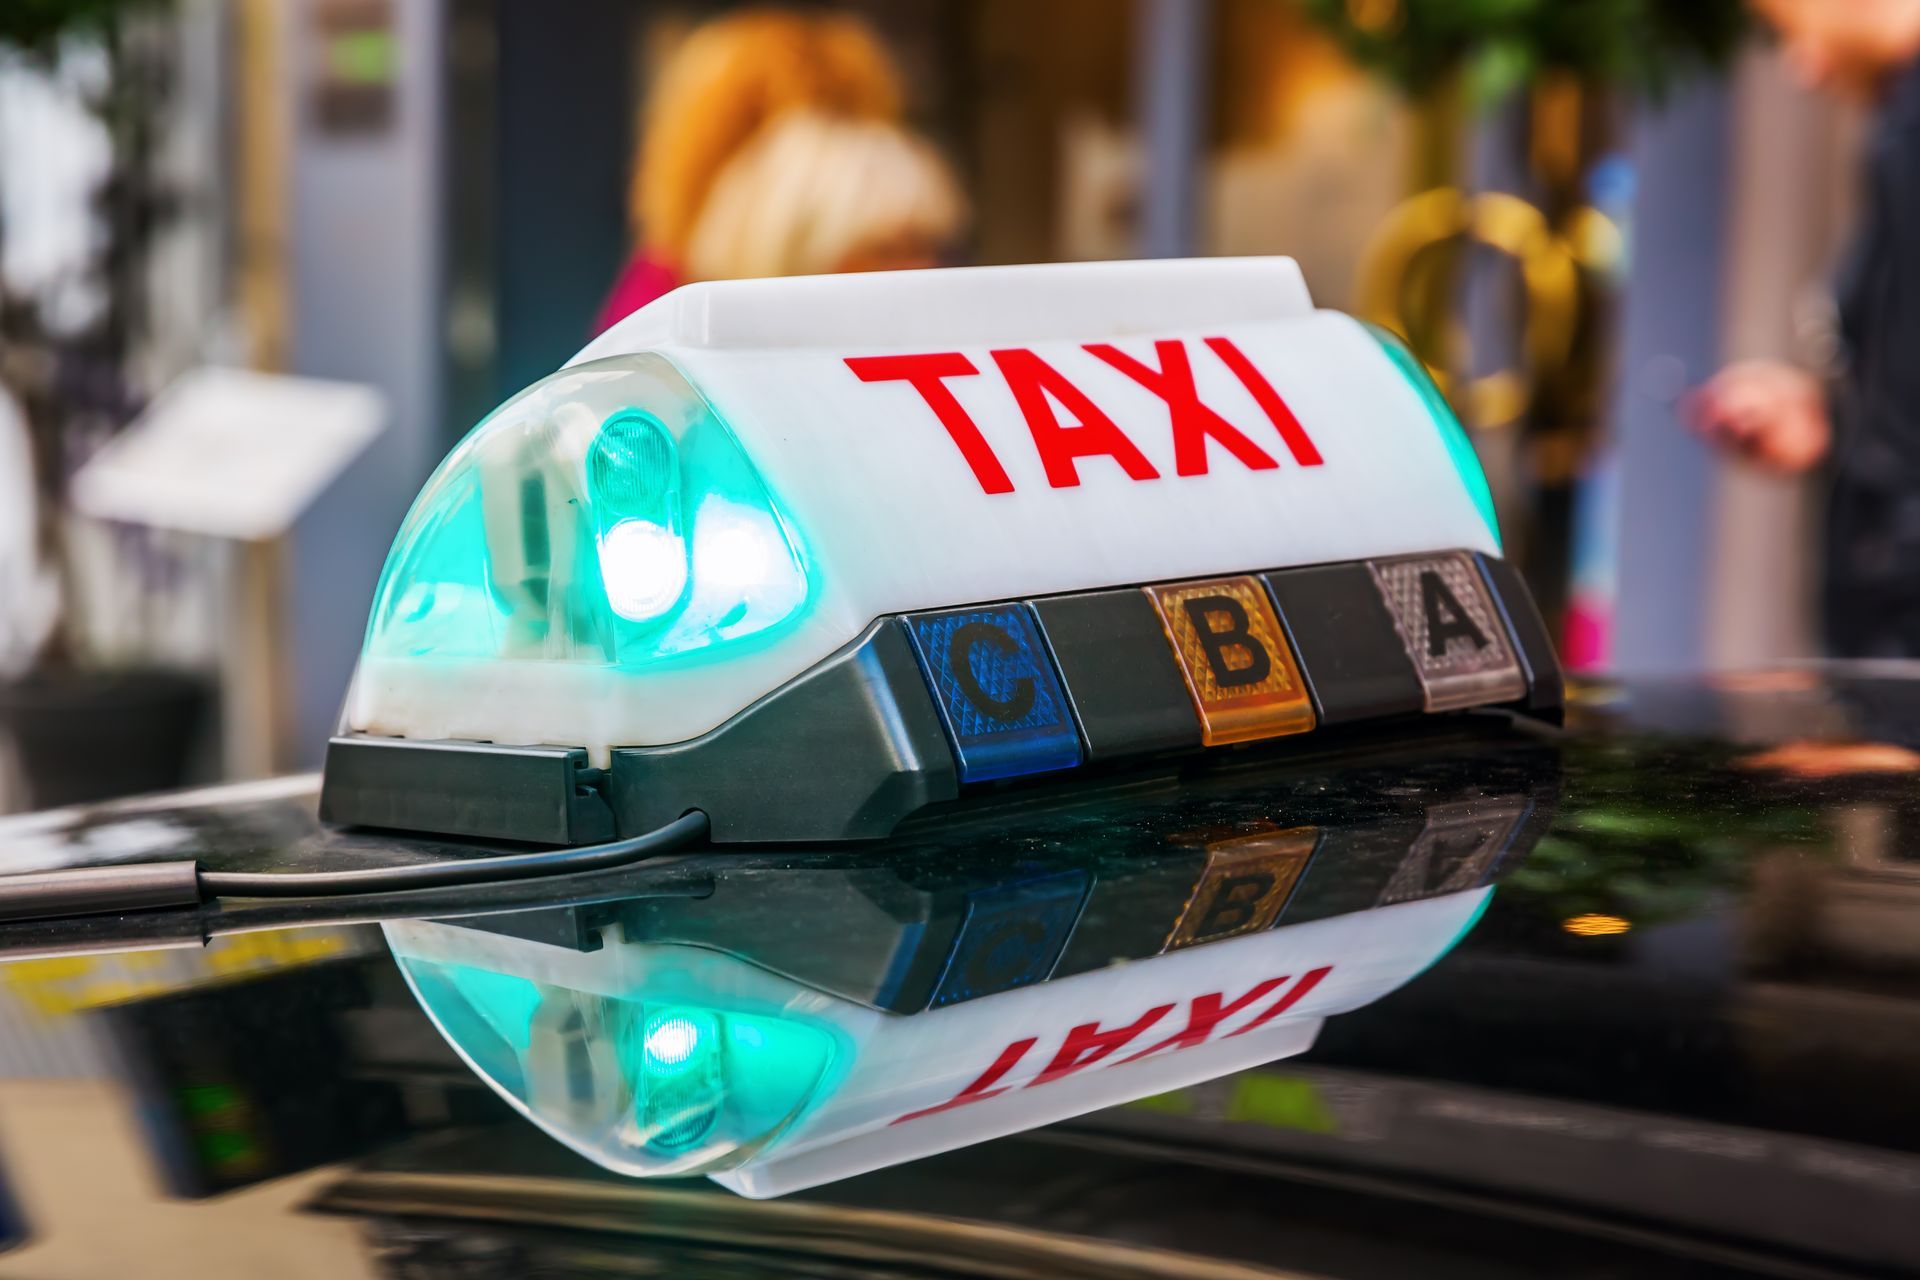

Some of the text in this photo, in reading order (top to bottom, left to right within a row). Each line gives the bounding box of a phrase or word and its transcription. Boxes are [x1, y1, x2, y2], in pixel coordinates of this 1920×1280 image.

[843, 336, 1324, 494] TAXI
[951, 571, 1489, 722] C B A
